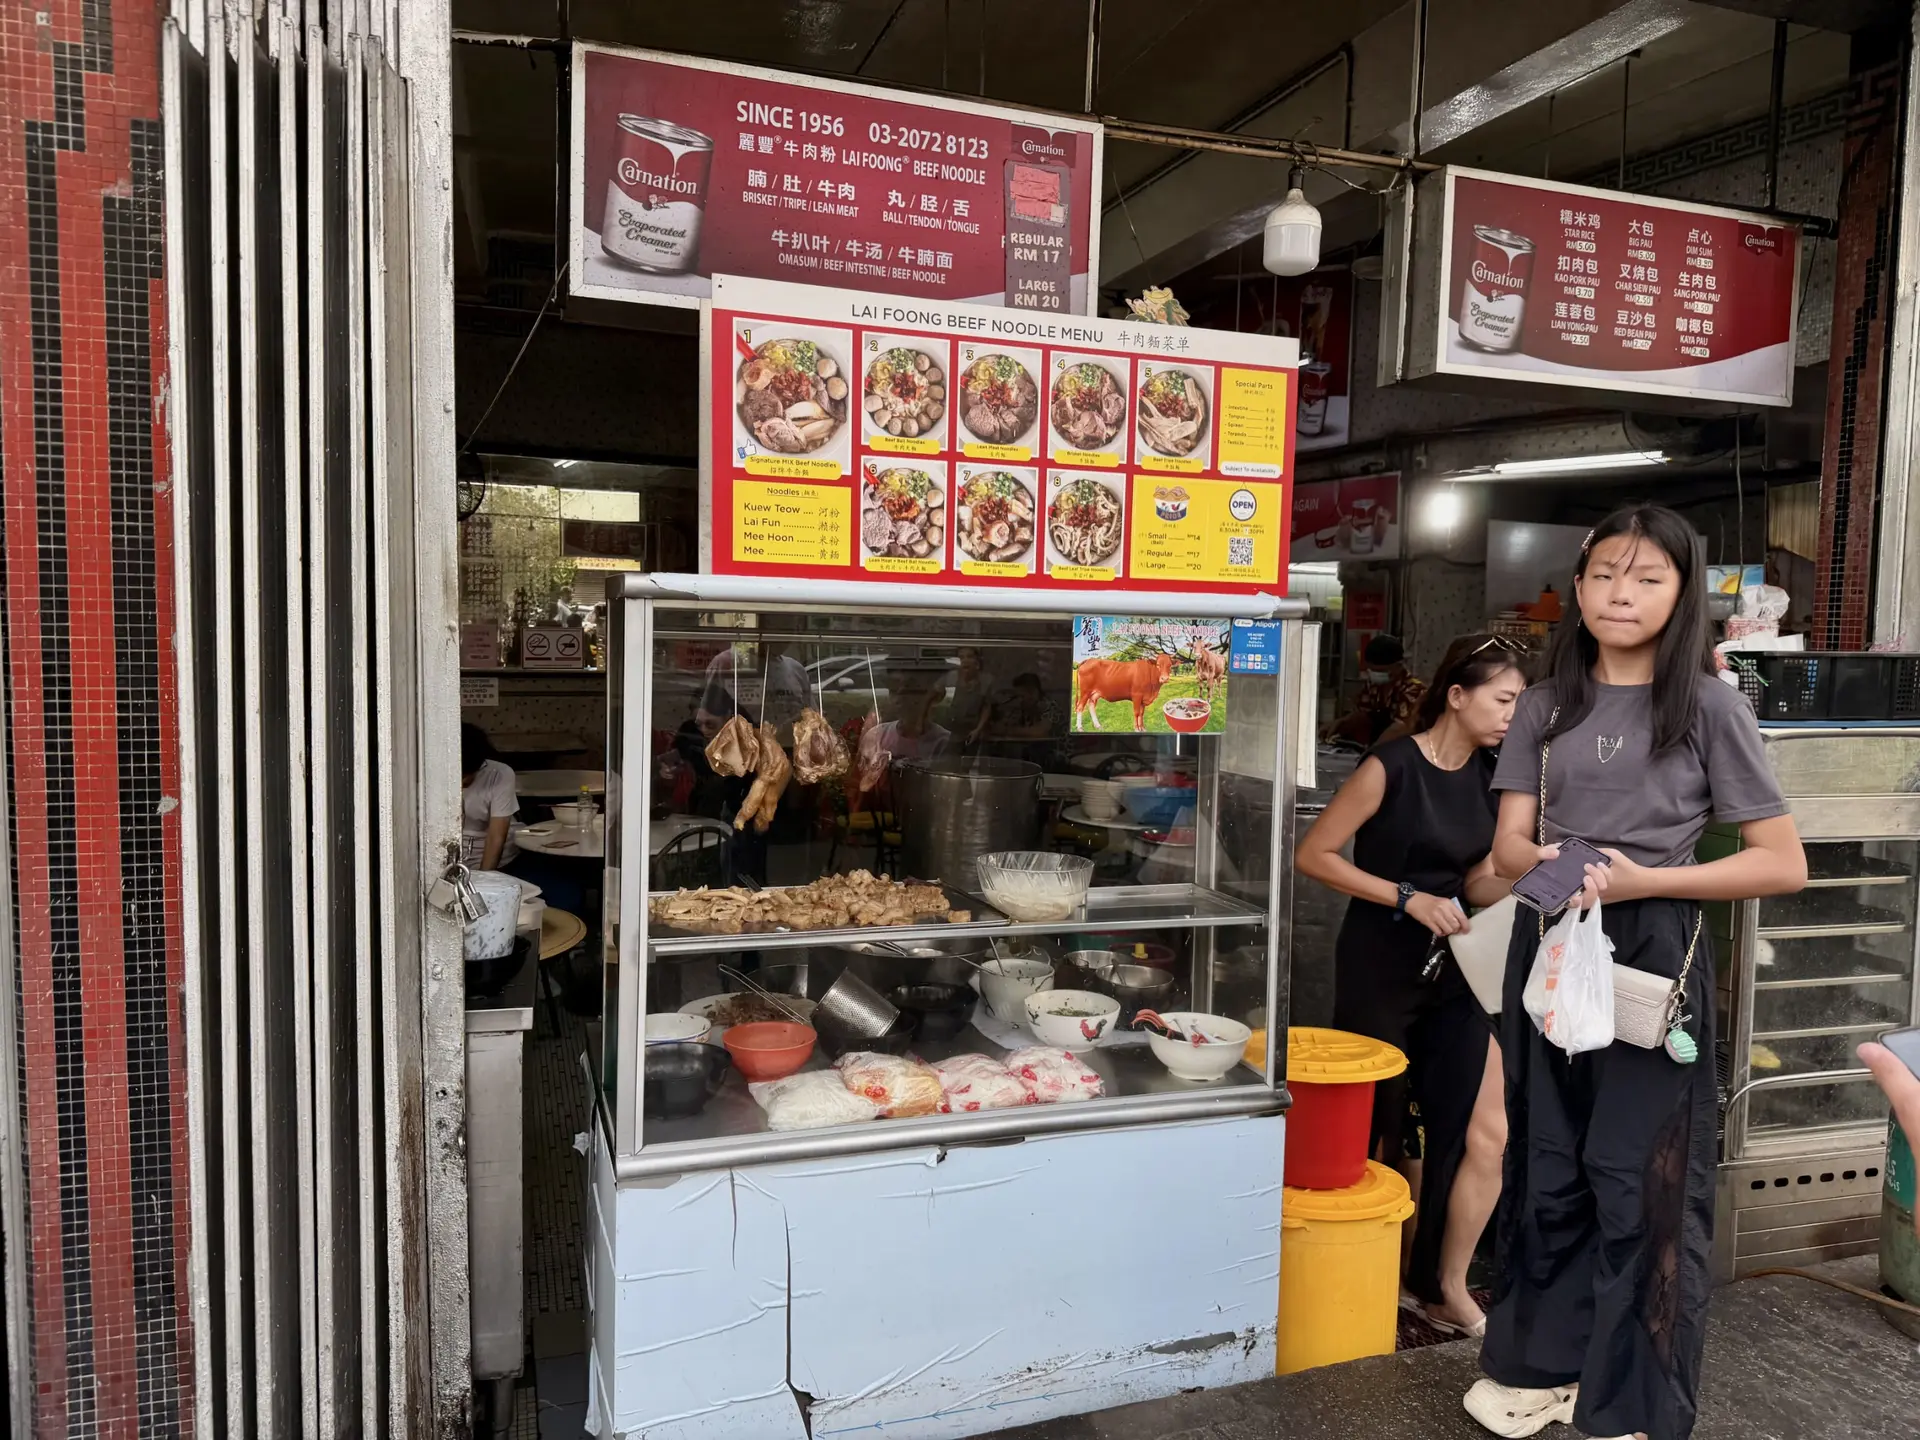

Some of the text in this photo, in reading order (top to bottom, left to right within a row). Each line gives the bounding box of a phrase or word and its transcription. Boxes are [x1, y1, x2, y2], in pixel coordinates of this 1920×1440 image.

[736, 100, 845, 137] SINCE 1956
[868, 122, 989, 159] 03-2072 8123
[1022, 139, 1065, 157] Carnation
[842, 149, 860, 167] LAI
[914, 160, 939, 178] BEEF
[941, 165, 986, 185] NOODLE
[617, 157, 697, 195] Carnation
[783, 174, 802, 193] 肚
[817, 180, 855, 201] 牛肉
[742, 190, 859, 218] BRISKET TRIPE LEAN MEAT
[888, 189, 906, 209] 丸
[952, 199, 970, 218] 舌
[618, 209, 687, 238] Evaporated
[882, 210, 980, 235] BALL TENDON TONGUE
[1628, 219, 1654, 237] 大包
[625, 228, 677, 249] Creamer
[1010, 232, 1064, 248] REGULAR
[1564, 228, 1595, 241] STAR RICE
[771, 230, 830, 254] 牛扒叶
[845, 239, 883, 261] 牛汤
[1629, 237, 1653, 249] BIG PAU
[1014, 248, 1060, 264] RM 17
[1686, 245, 1712, 257] DIM SUM
[778, 253, 946, 285] OMASUM BEEF INTESTINE BEEF NOODLE
[1557, 255, 1598, 274] 扣肉包
[1471, 260, 1525, 289] Carnation
[1554, 273, 1600, 287] KAO PORK PAU
[1678, 271, 1717, 290] 生肉包
[1018, 278, 1056, 293] LARGE
[1615, 281, 1632, 292] CHAR
[1648, 285, 1661, 295] PAU
[1014, 293, 1060, 309] RM 20
[1673, 288, 1690, 298] SANG
[1691, 291, 1707, 300] PORK
[851, 304, 1104, 343] LAI FOONG BEEF NOODLE MENU
[1551, 320, 1567, 330] LIAN
[1616, 310, 1656, 328] 豆沙包
[744, 329, 752, 344] 1
[1614, 327, 1657, 340] RED BEAN PAU
[1680, 335, 1695, 344] KAYA
[870, 341, 878, 351] 2
[966, 349, 974, 361] 3
[1057, 359, 1065, 370] 4
[1235, 380, 1273, 390] Special Parts
[750, 456, 780, 465] Signature
[811, 461, 837, 469] Noodles
[869, 463, 878, 474] 6
[963, 470, 971, 481] 7
[767, 487, 800, 496] Noodles
[744, 502, 801, 514] Kuew Teow
[1232, 500, 1254, 510] OPEN
[743, 517, 781, 527] Lai Fun
[743, 532, 794, 542] Mee Hoon
[1148, 532, 1167, 540] Small
[743, 546, 764, 555] Mee
[1146, 550, 1173, 558] Regular
[1146, 562, 1166, 570] Large
